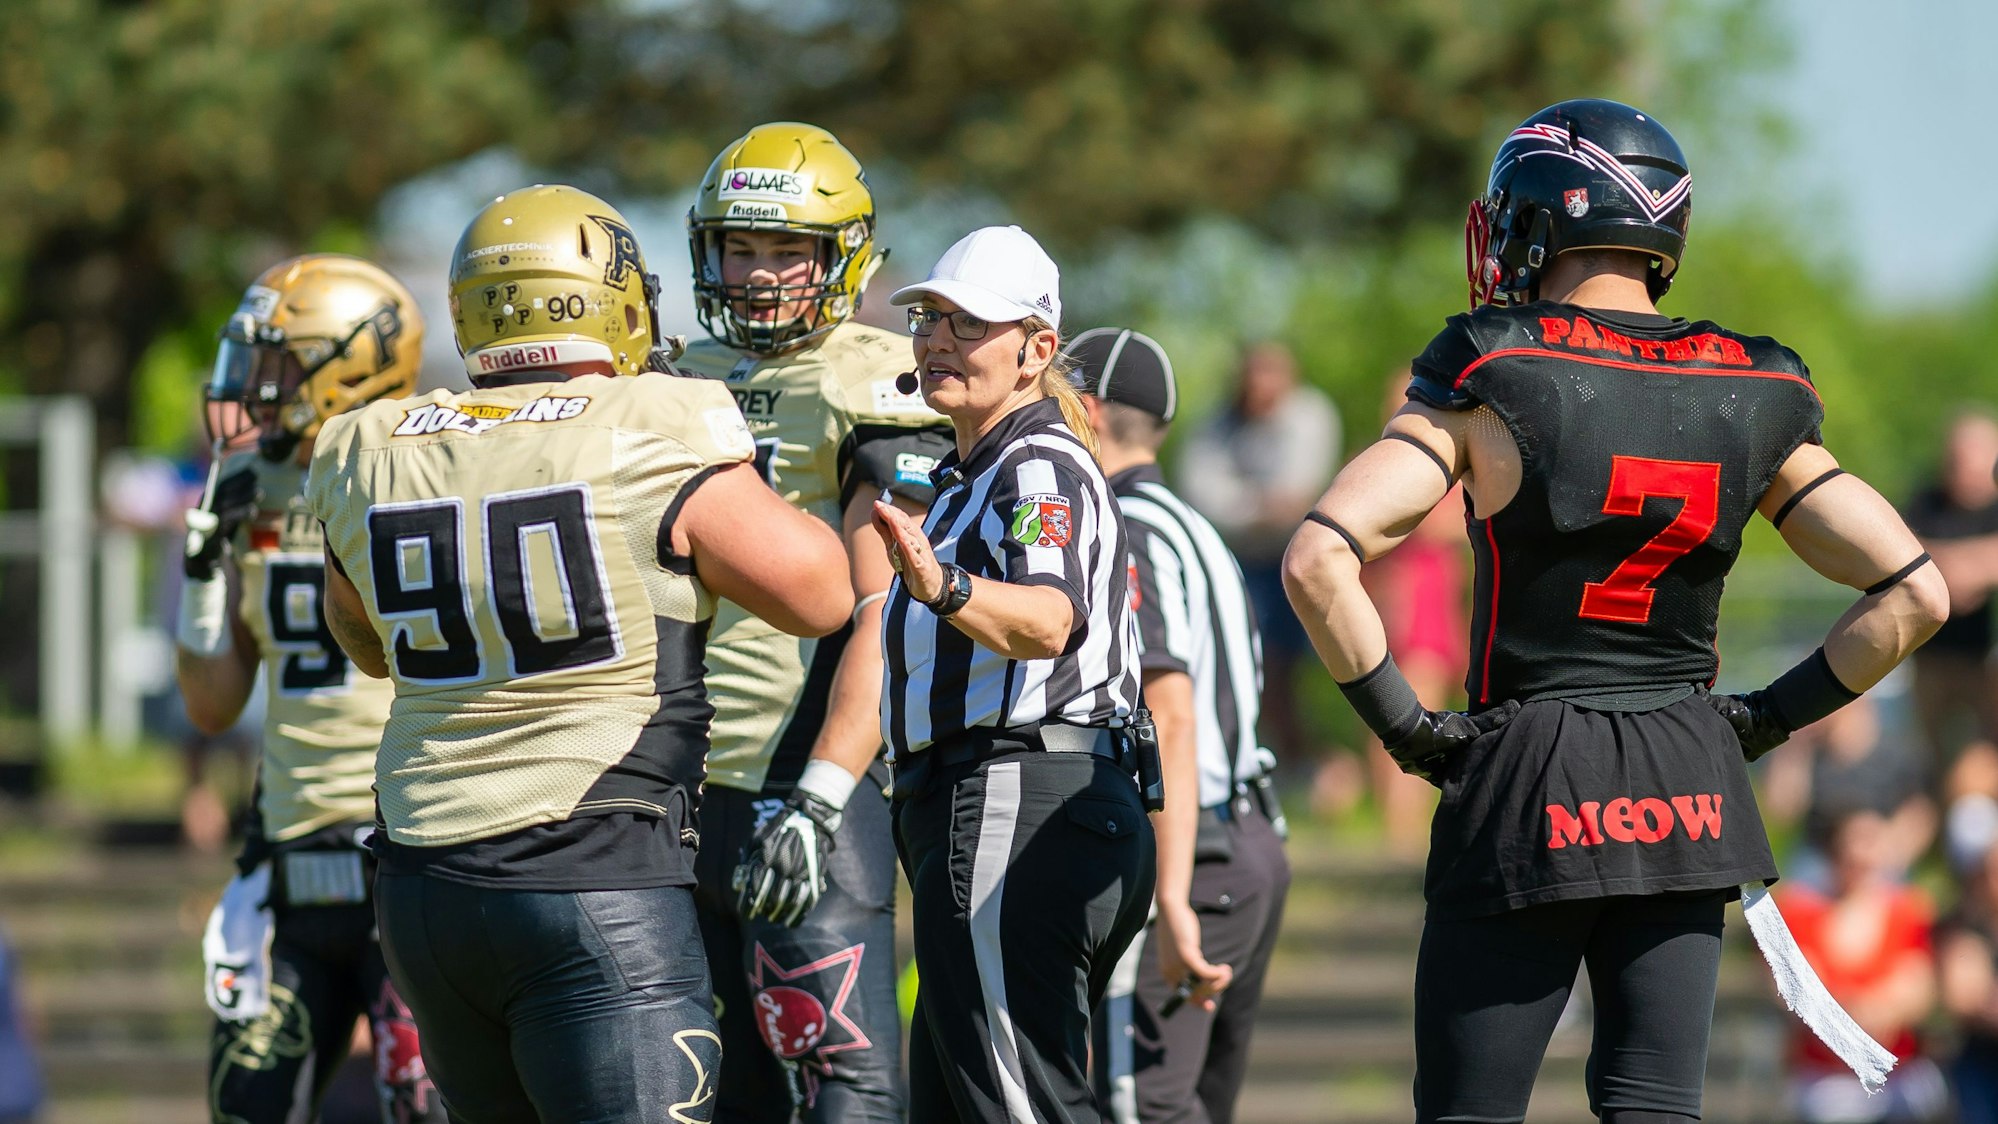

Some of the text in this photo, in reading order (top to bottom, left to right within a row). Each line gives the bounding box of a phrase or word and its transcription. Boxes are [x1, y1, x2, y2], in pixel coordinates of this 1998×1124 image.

[732, 205, 779, 217] Riddell
[547, 294, 585, 322] 90
[1539, 316, 1753, 366] PANTHER
[478, 346, 559, 371] Riddell
[733, 388, 783, 414] REY
[1578, 454, 1721, 624] 7
[364, 481, 626, 686] 90
